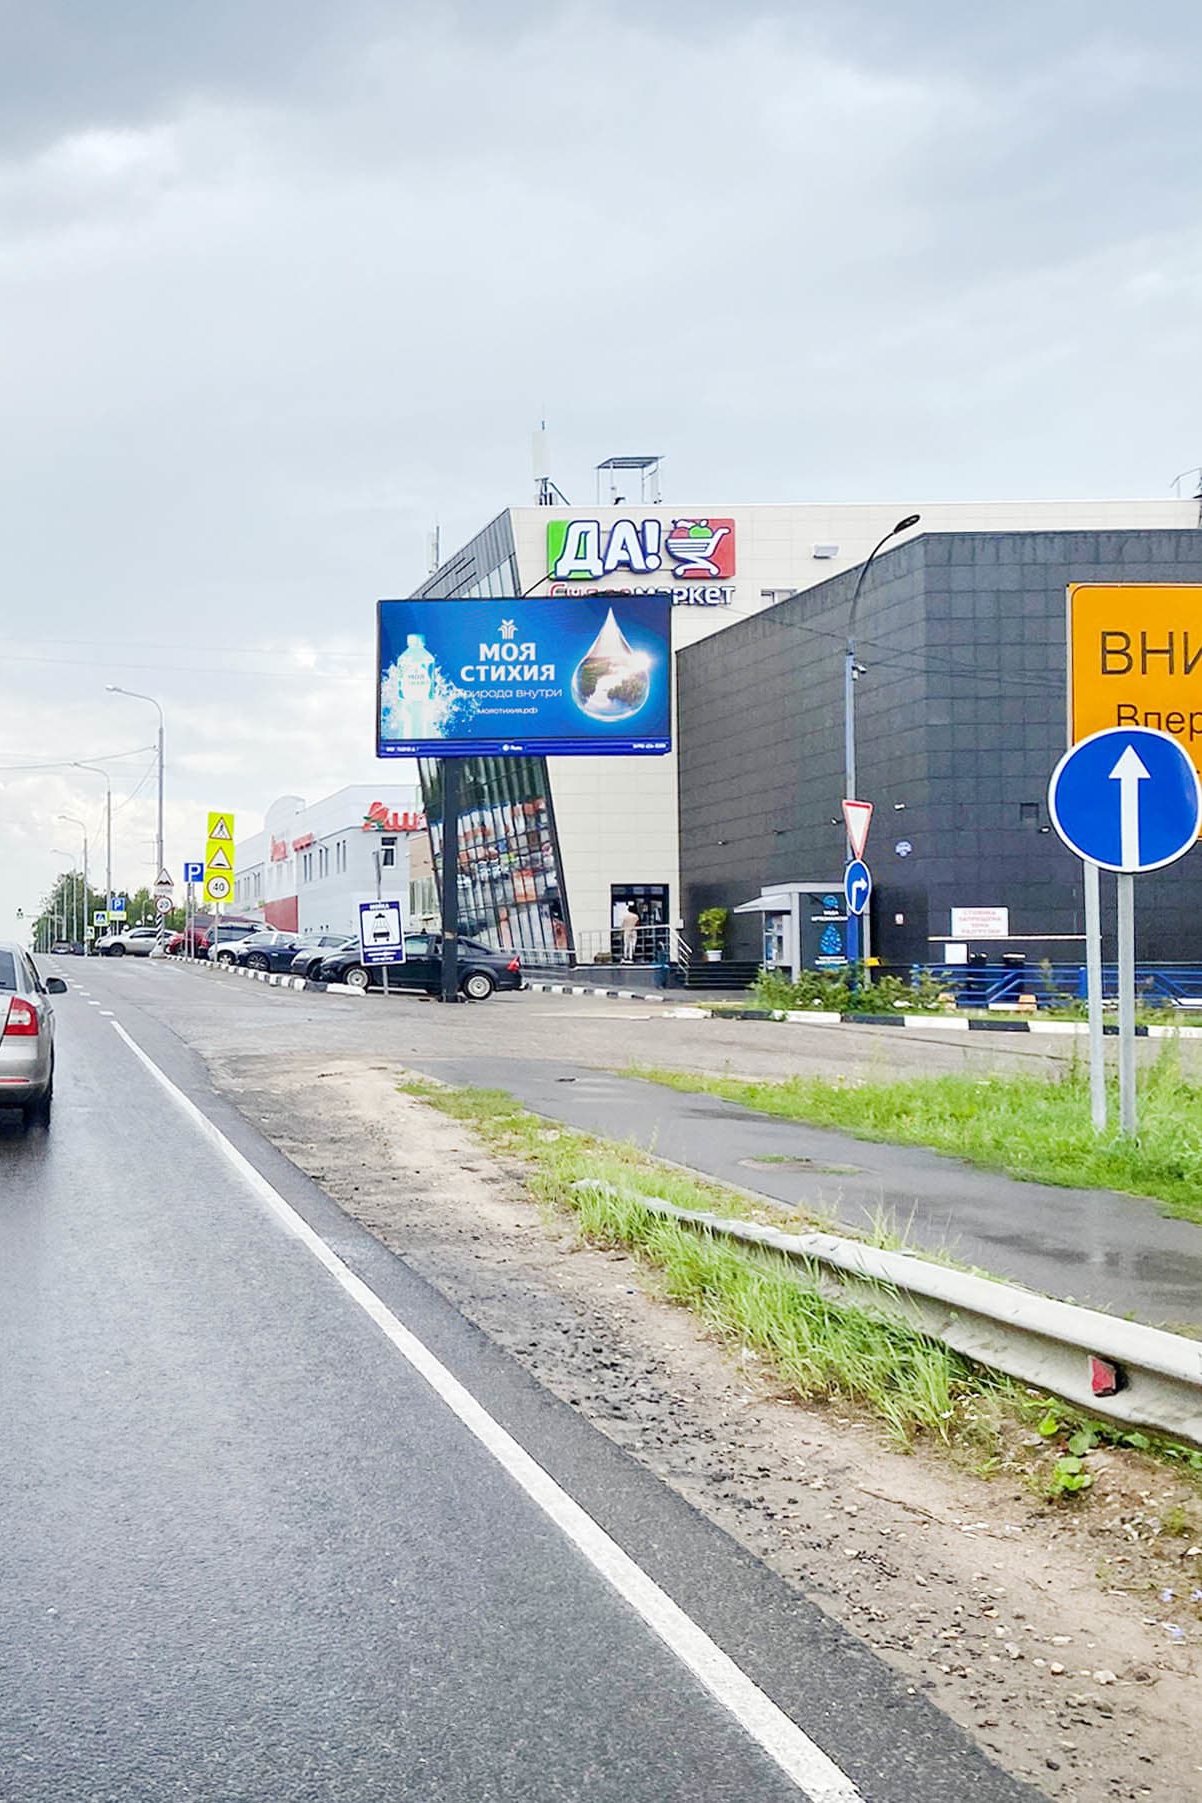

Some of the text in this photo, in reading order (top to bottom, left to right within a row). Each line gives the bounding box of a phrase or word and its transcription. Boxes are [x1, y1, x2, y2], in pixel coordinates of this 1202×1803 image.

[554, 519, 662, 580] ДА!
[479, 643, 536, 662] МОЯ
[460, 665, 556, 682] СТИХИЯ
[516, 688, 563, 699] внутри
[189, 864, 202, 882] P
[213, 882, 225, 892] 40
